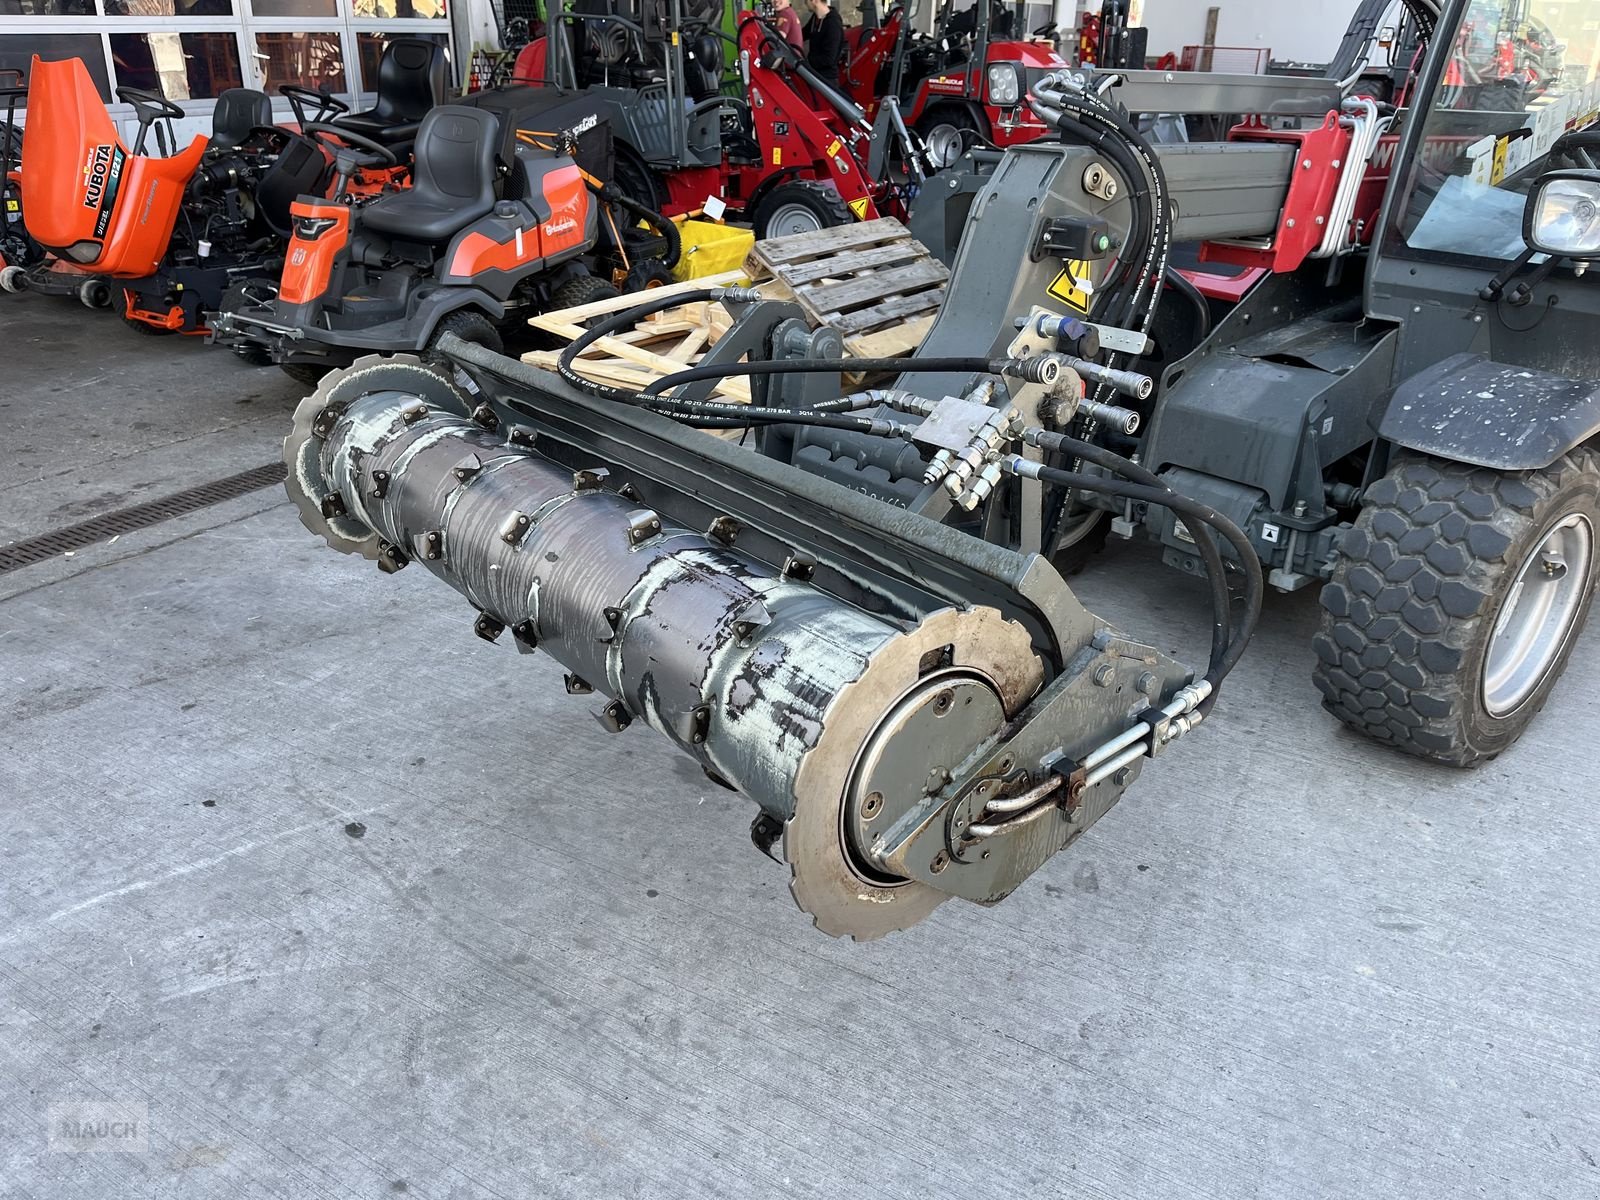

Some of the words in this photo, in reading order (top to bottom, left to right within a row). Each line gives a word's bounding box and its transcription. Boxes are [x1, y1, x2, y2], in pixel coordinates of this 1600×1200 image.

[84, 145, 111, 209] KUBOTA
[97, 210, 109, 236] DIESEL
[636, 393, 656, 401] BRESSEL
